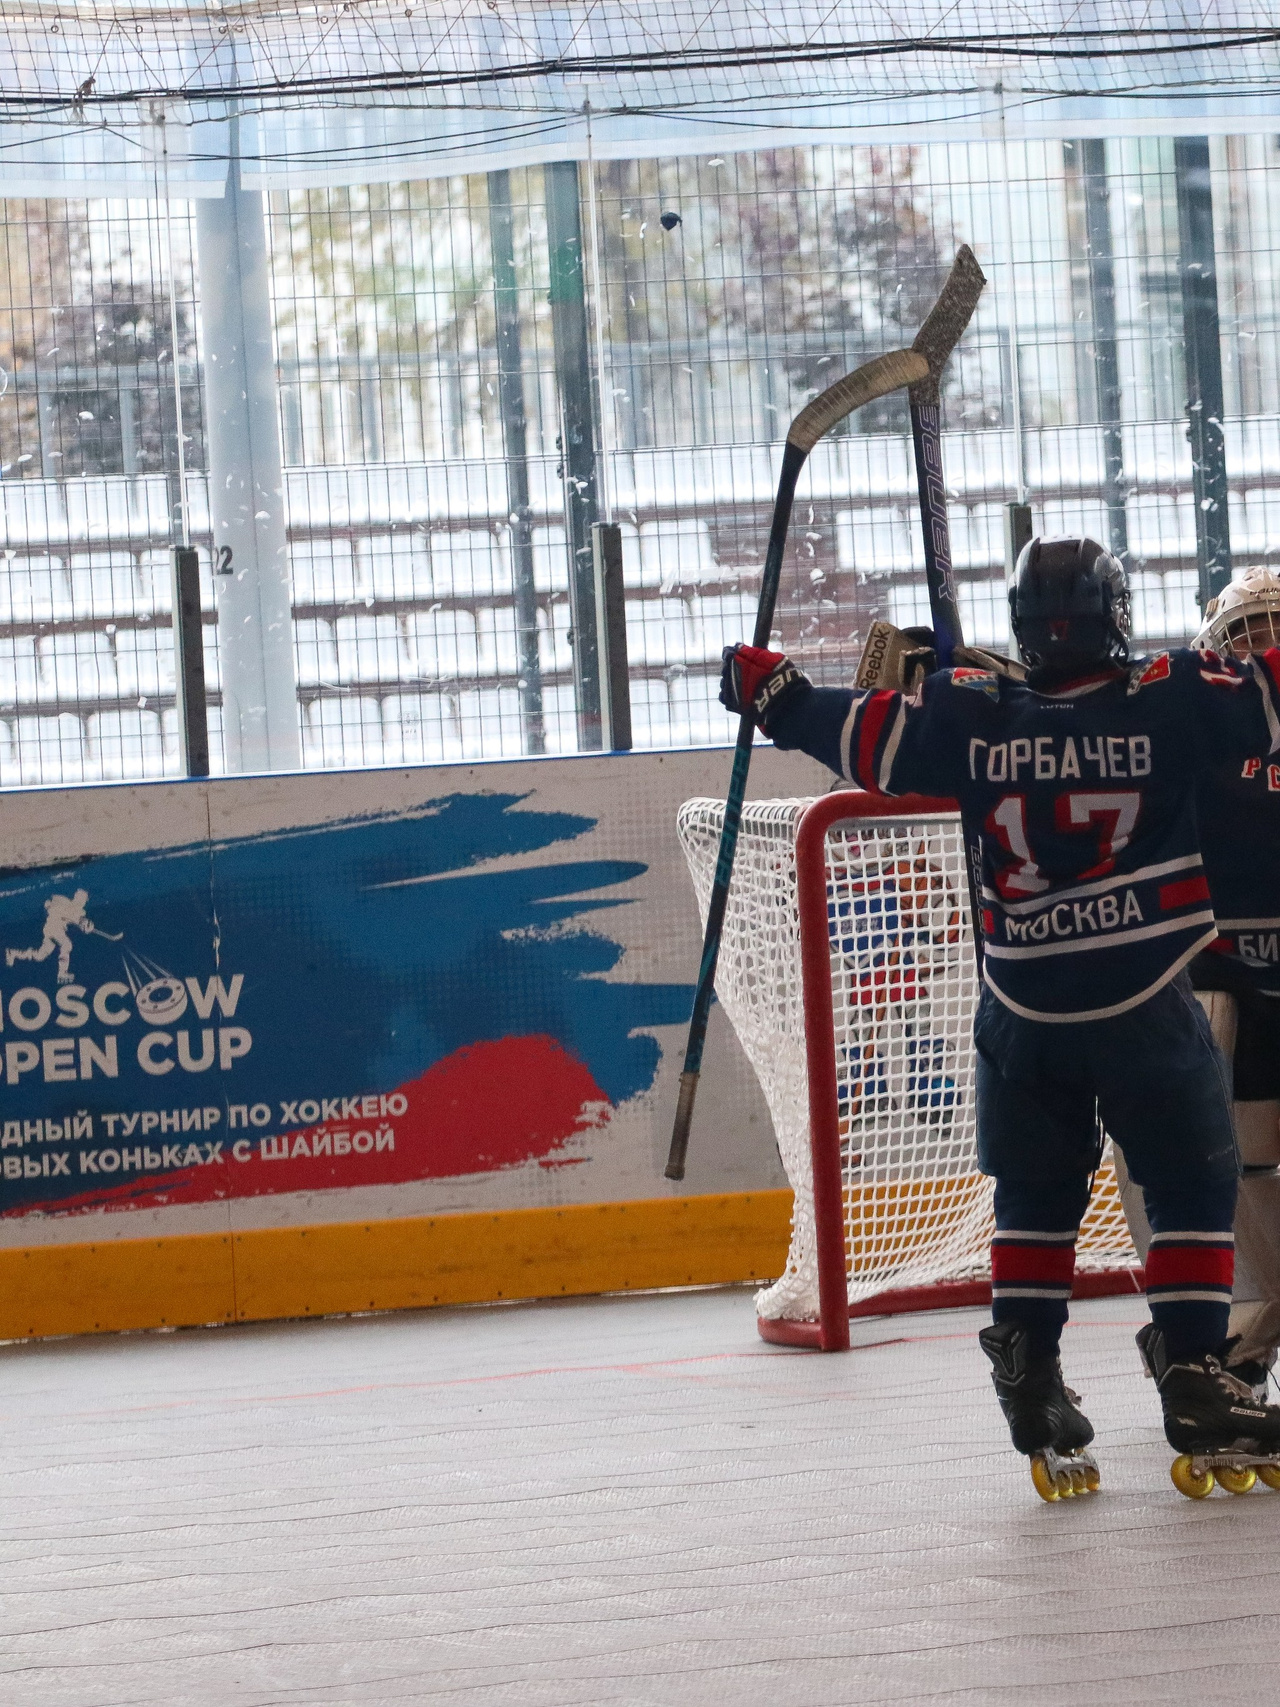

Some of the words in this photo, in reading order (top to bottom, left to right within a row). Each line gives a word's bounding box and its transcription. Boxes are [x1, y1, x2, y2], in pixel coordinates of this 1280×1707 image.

[859, 627, 890, 690] Reebok
[754, 668, 804, 713] UER
[969, 735, 1152, 782] ГОРБАЧЕВ
[985, 791, 1142, 899] 17
[1004, 890, 1143, 942] МОСКВА
[0, 974, 245, 1032] OSCOW
[0, 1035, 119, 1085] PEN
[137, 1027, 253, 1076] CUP
[1, 1109, 94, 1148] ДНЫЙ
[101, 1106, 221, 1138] ТУРНИР
[229, 1102, 272, 1129] ПО
[280, 1093, 409, 1126] ХОККЕЮ
[0, 1151, 72, 1180] ВЫХ
[79, 1140, 224, 1175] КОНЬКАХ
[232, 1138, 252, 1164] С
[260, 1123, 396, 1162] ШАЙБОЙ
